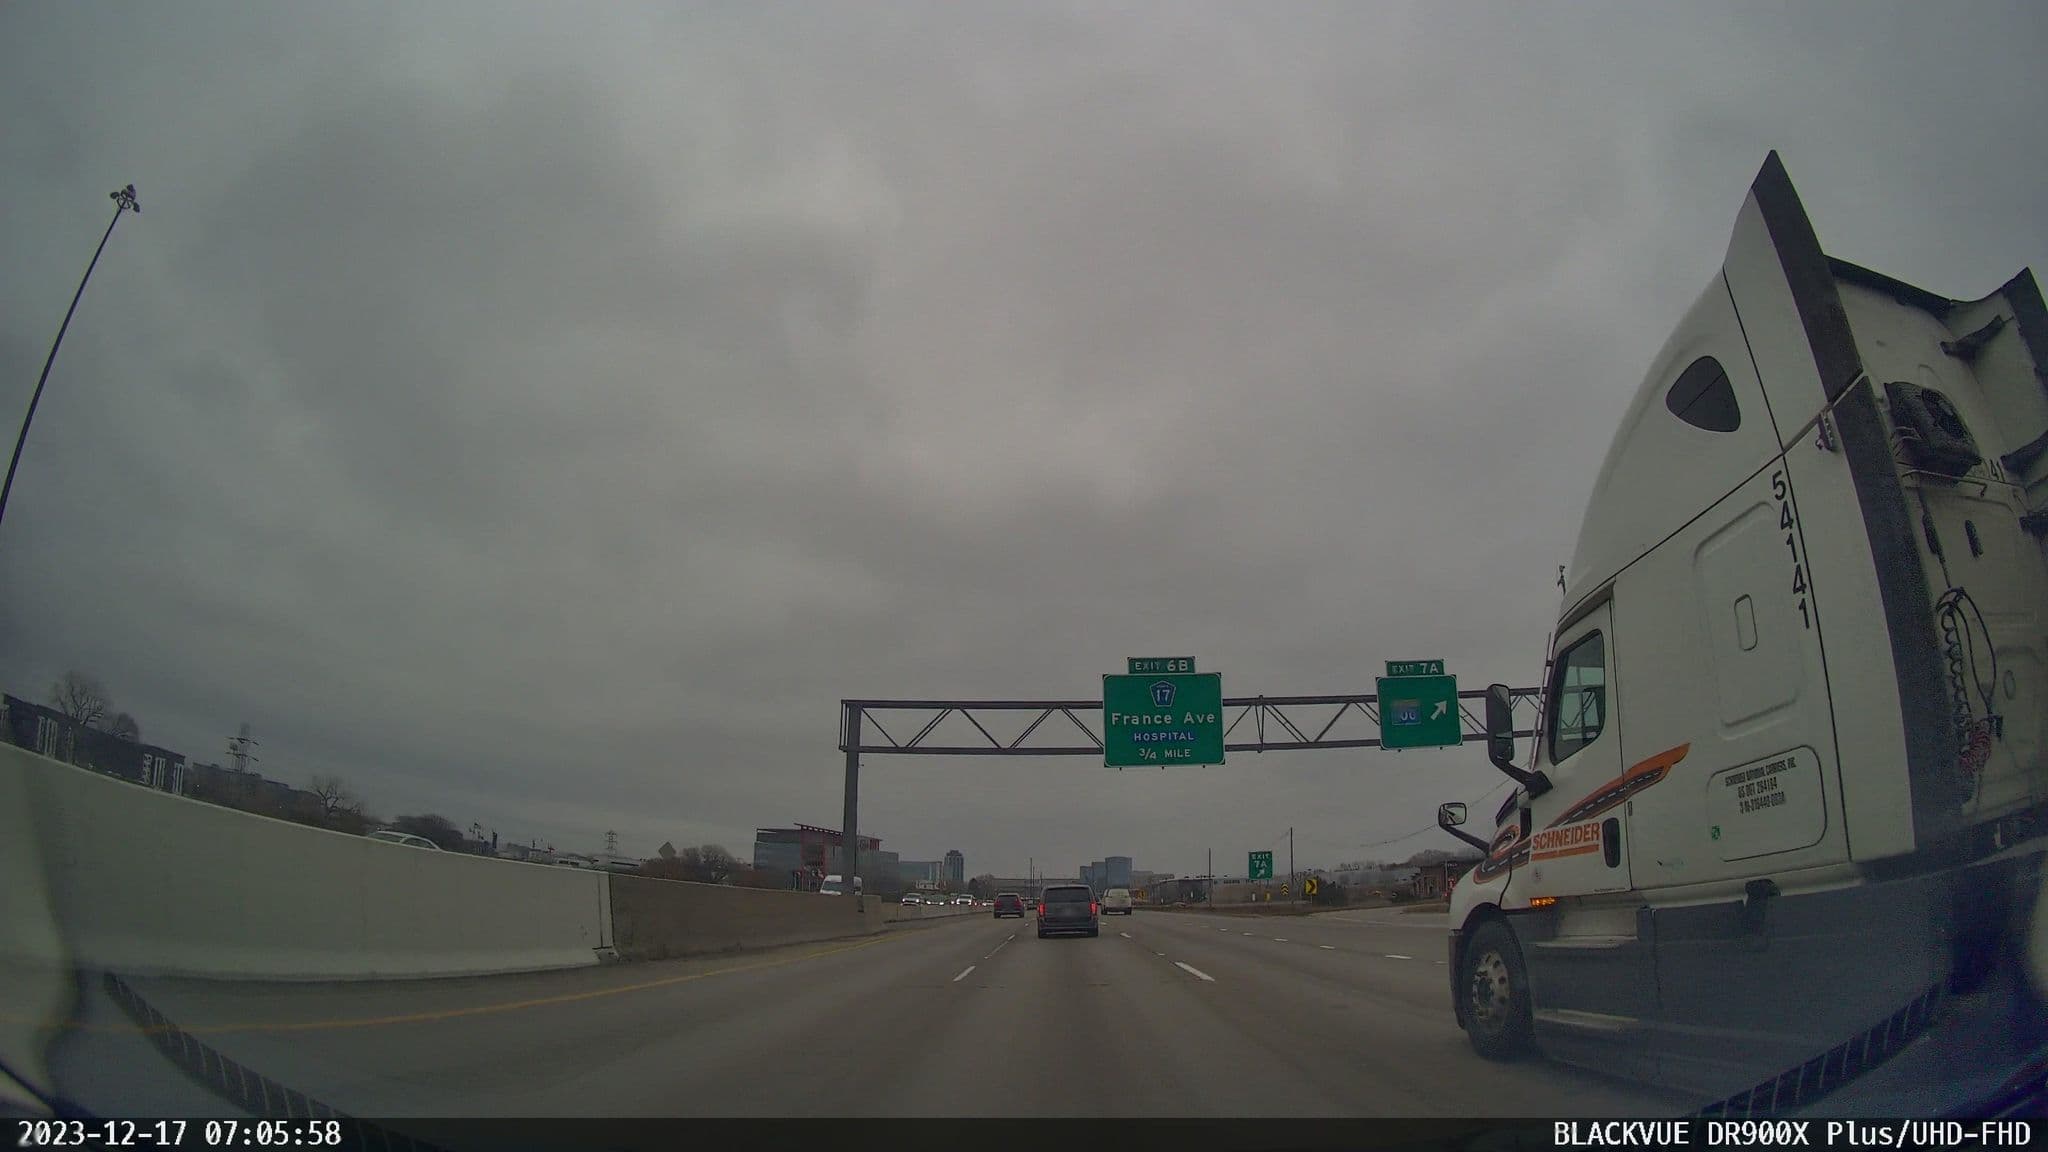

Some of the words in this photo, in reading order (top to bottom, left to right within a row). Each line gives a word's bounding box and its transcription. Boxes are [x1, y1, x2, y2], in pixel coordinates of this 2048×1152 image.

[1771, 470, 1810, 629] 54141
[1135, 661, 1160, 671] EXIT
[1167, 660, 1189, 672] 6B
[1391, 664, 1414, 673] EXIT
[1420, 662, 1439, 674] 7A
[1156, 689, 1171, 702] 17
[1111, 712, 1172, 725] France
[1183, 711, 1215, 724] Ave
[1133, 731, 1195, 742] HOSPITAL
[1139, 748, 1157, 760] 3/4
[1164, 748, 1192, 758] MILE
[1532, 822, 1600, 850] SCHNEIDER
[1254, 860, 1268, 868] 7A
